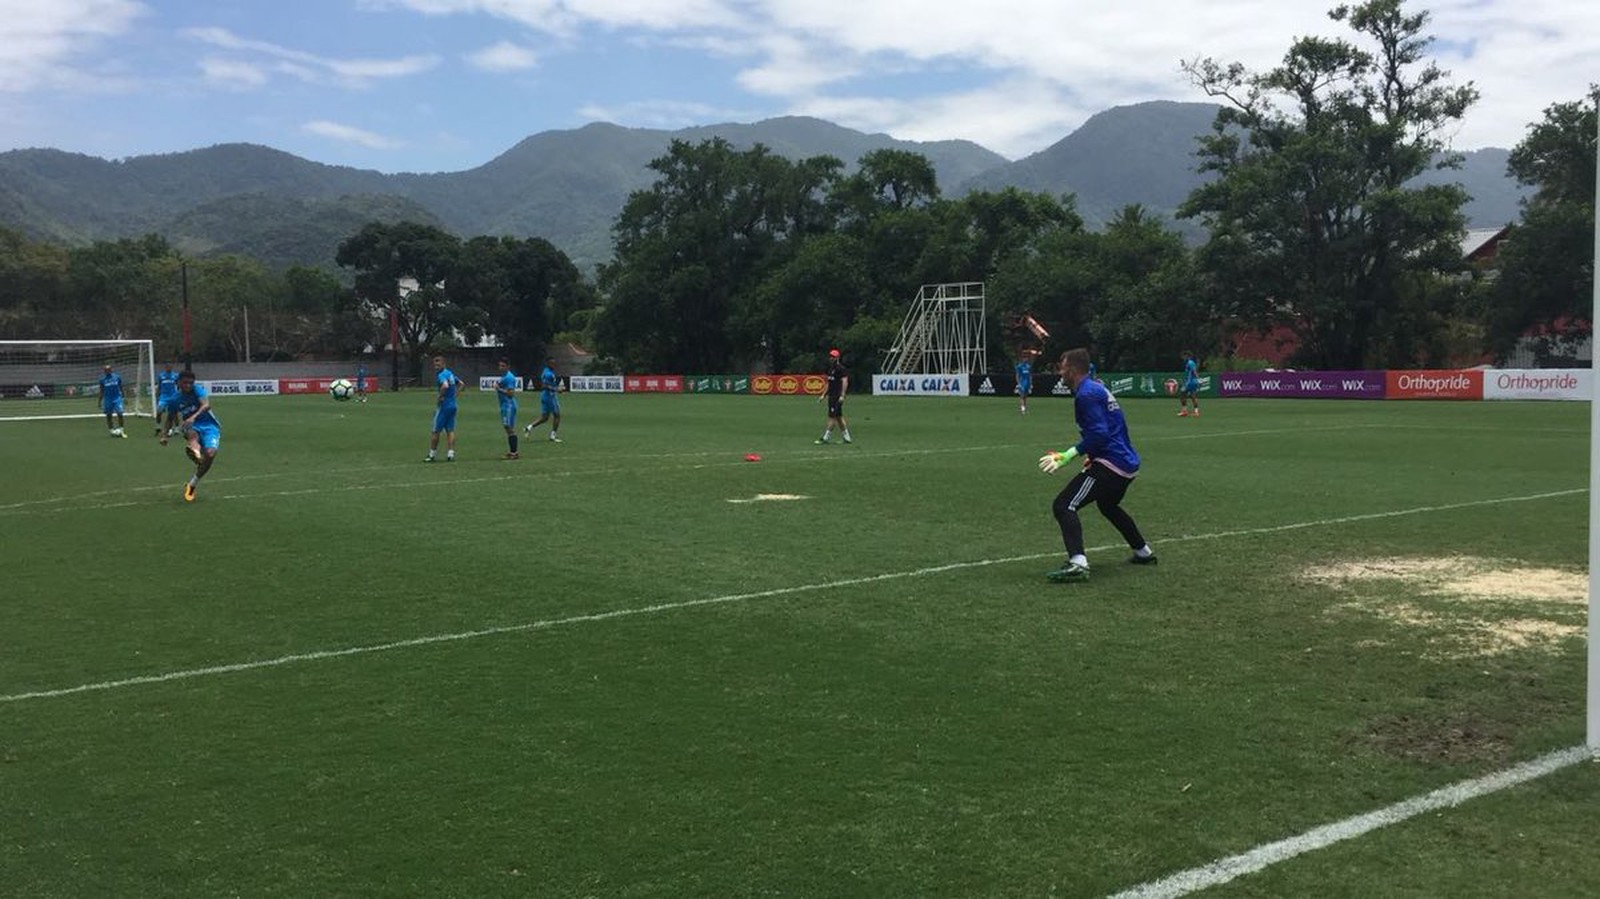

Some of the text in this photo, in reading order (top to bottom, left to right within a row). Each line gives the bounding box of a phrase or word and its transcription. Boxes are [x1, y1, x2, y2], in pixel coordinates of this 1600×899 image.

[880, 379, 961, 391] CAIXA CAIXA
[1398, 374, 1471, 392] Orthopride
[1497, 374, 1578, 392] Orthopride
